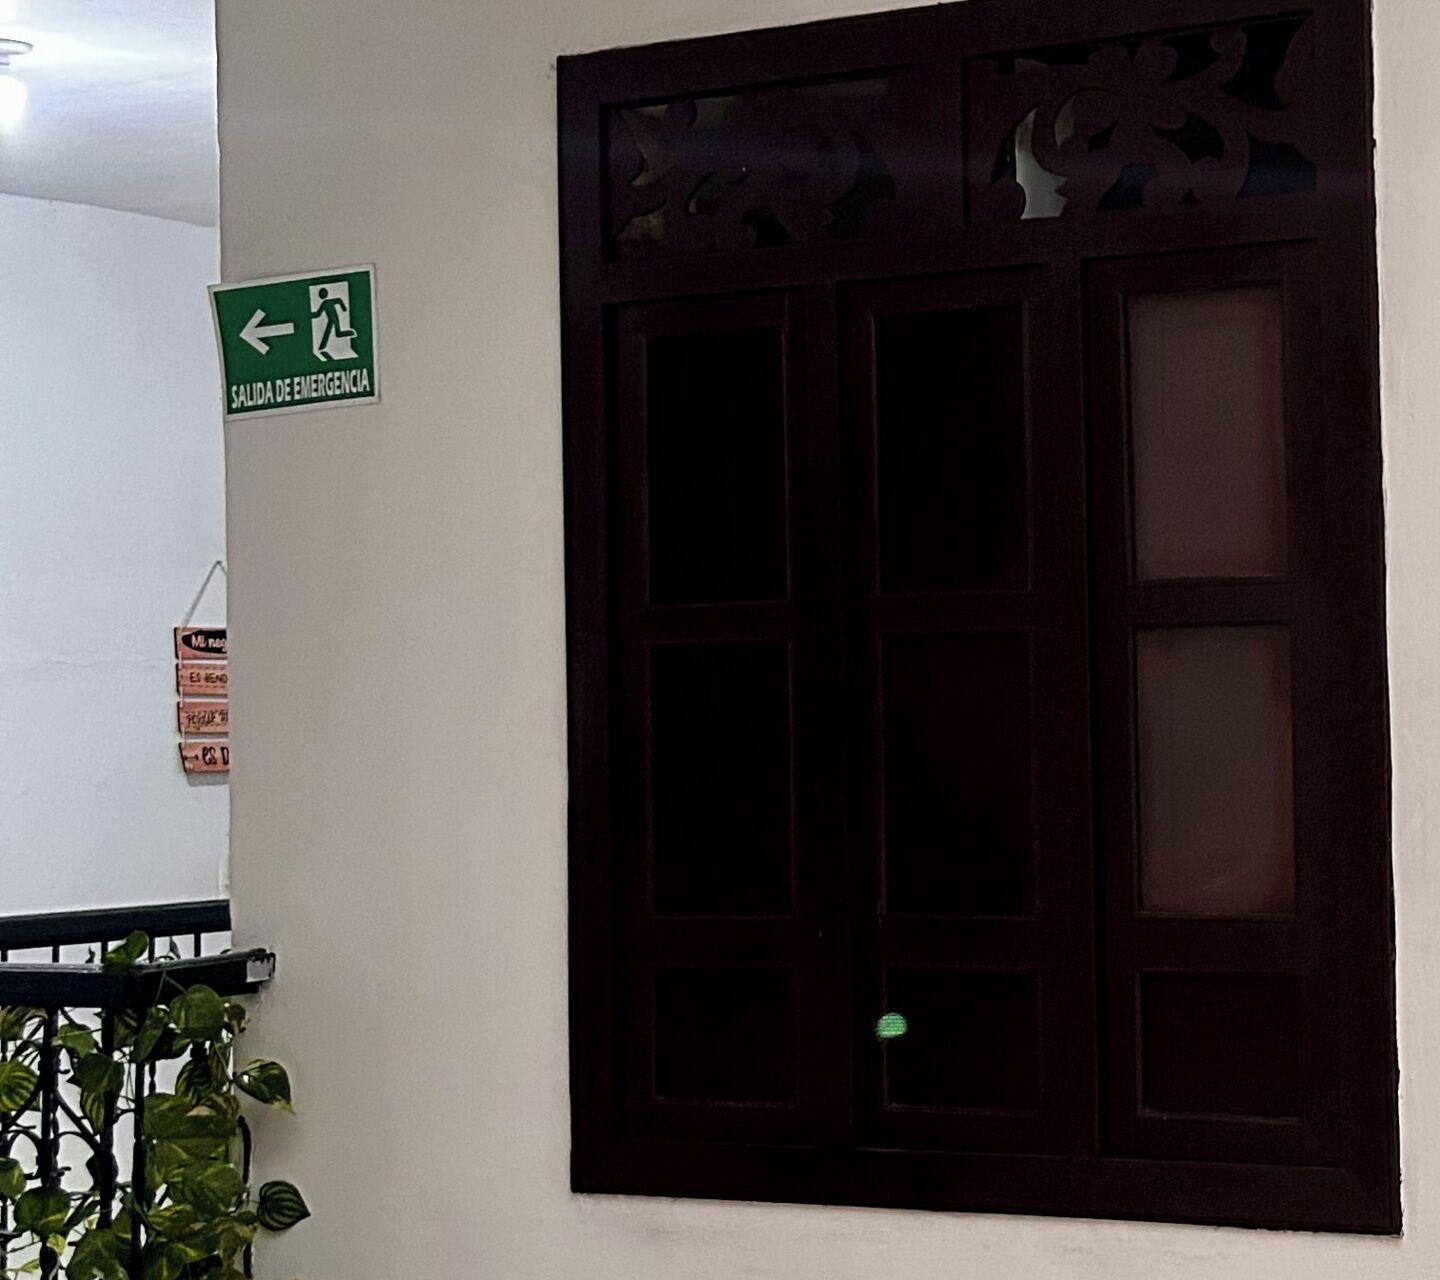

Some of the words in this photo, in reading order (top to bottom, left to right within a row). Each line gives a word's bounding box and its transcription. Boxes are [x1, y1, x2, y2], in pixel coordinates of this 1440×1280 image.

[231, 381, 274, 409] SALIDA
[275, 379, 291, 403] DE
[293, 368, 370, 400] EMERGENCIA
